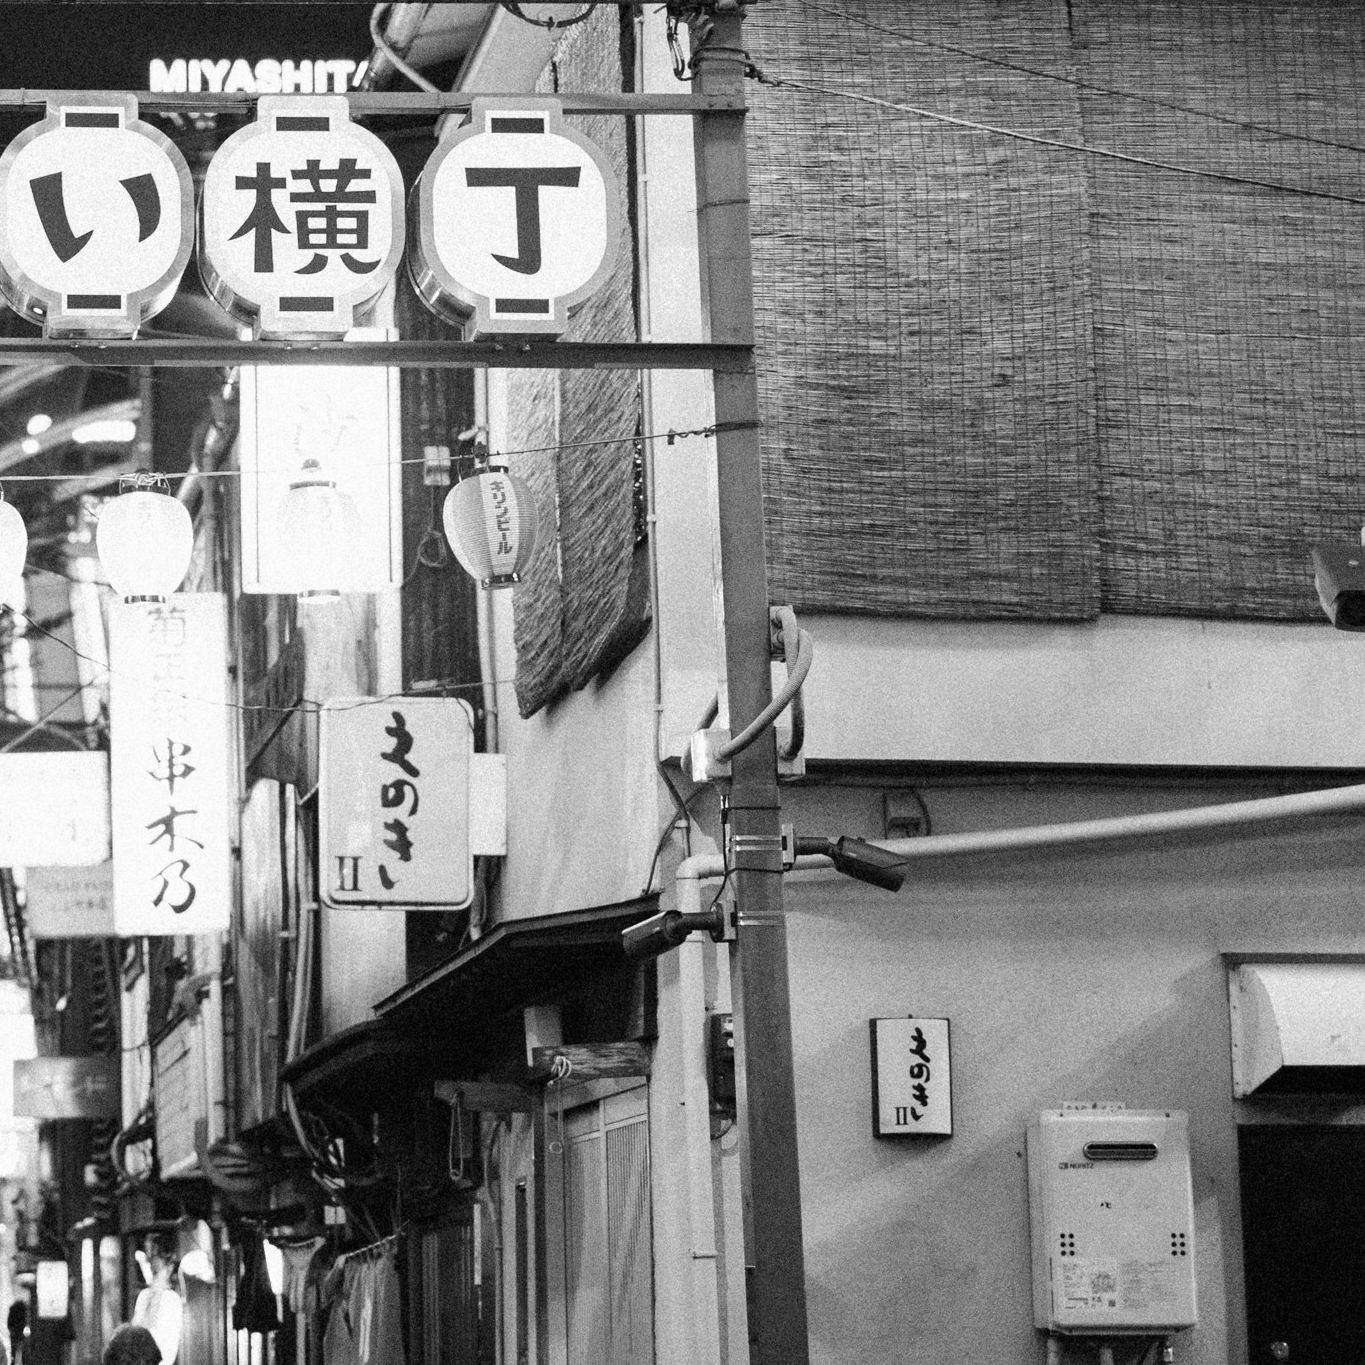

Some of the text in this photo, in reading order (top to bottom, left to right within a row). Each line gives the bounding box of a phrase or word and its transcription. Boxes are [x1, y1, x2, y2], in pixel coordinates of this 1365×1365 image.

[489, 480, 513, 555] キリンビール
[146, 737, 204, 914] 串木乃
